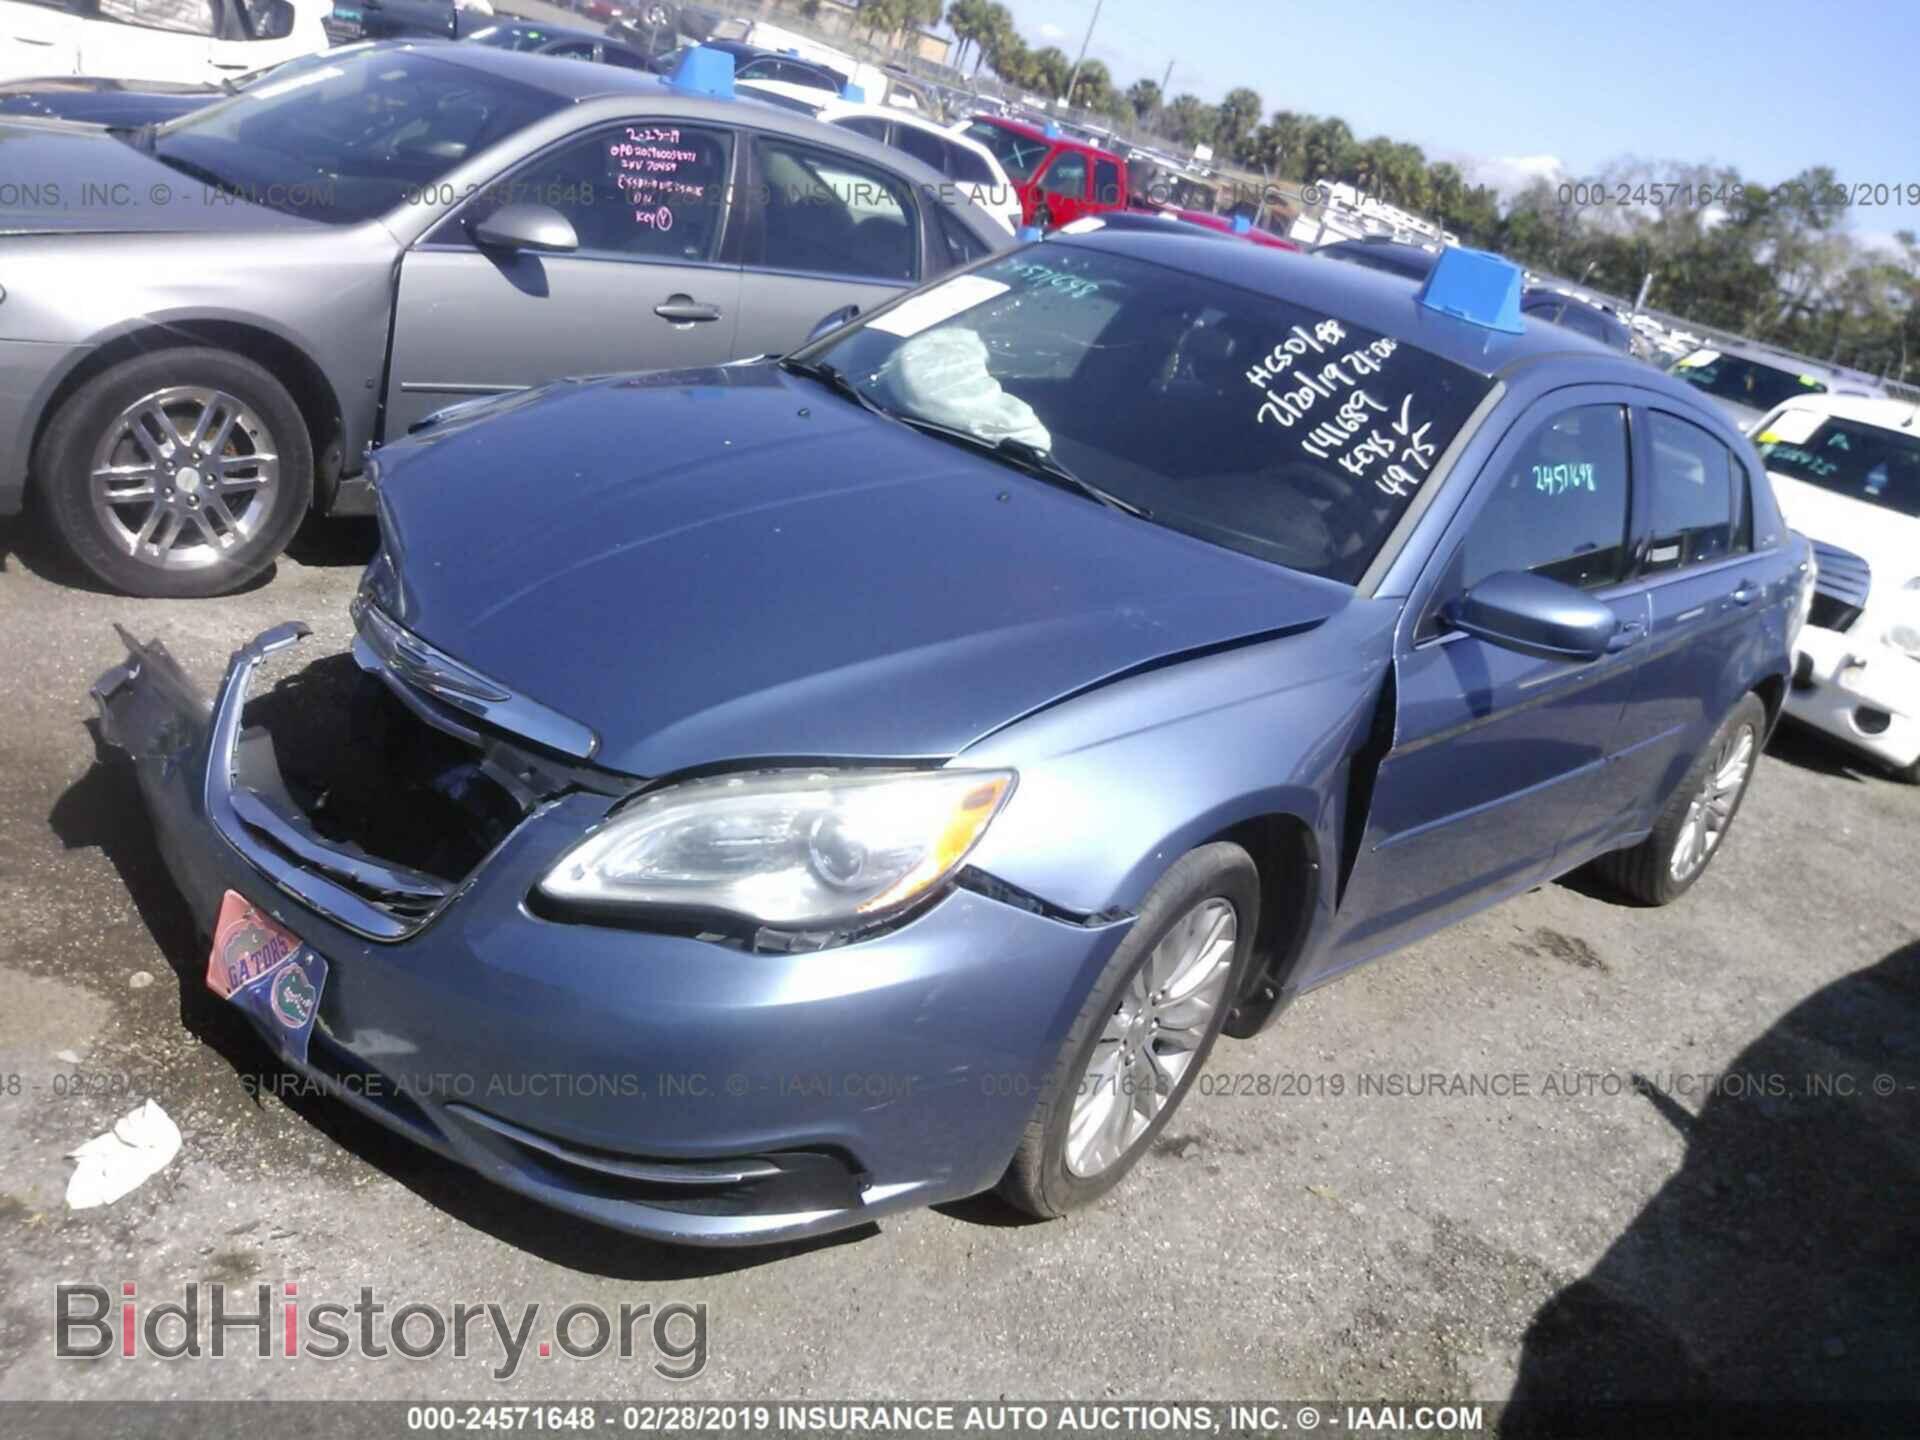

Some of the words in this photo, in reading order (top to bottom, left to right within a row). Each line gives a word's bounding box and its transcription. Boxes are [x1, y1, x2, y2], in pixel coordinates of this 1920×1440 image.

[1257, 363, 1356, 427] 2/20/19
[1301, 390, 1389, 458] 141689
[1338, 429, 1395, 476] KEYS
[227, 932, 290, 988] GATORS
